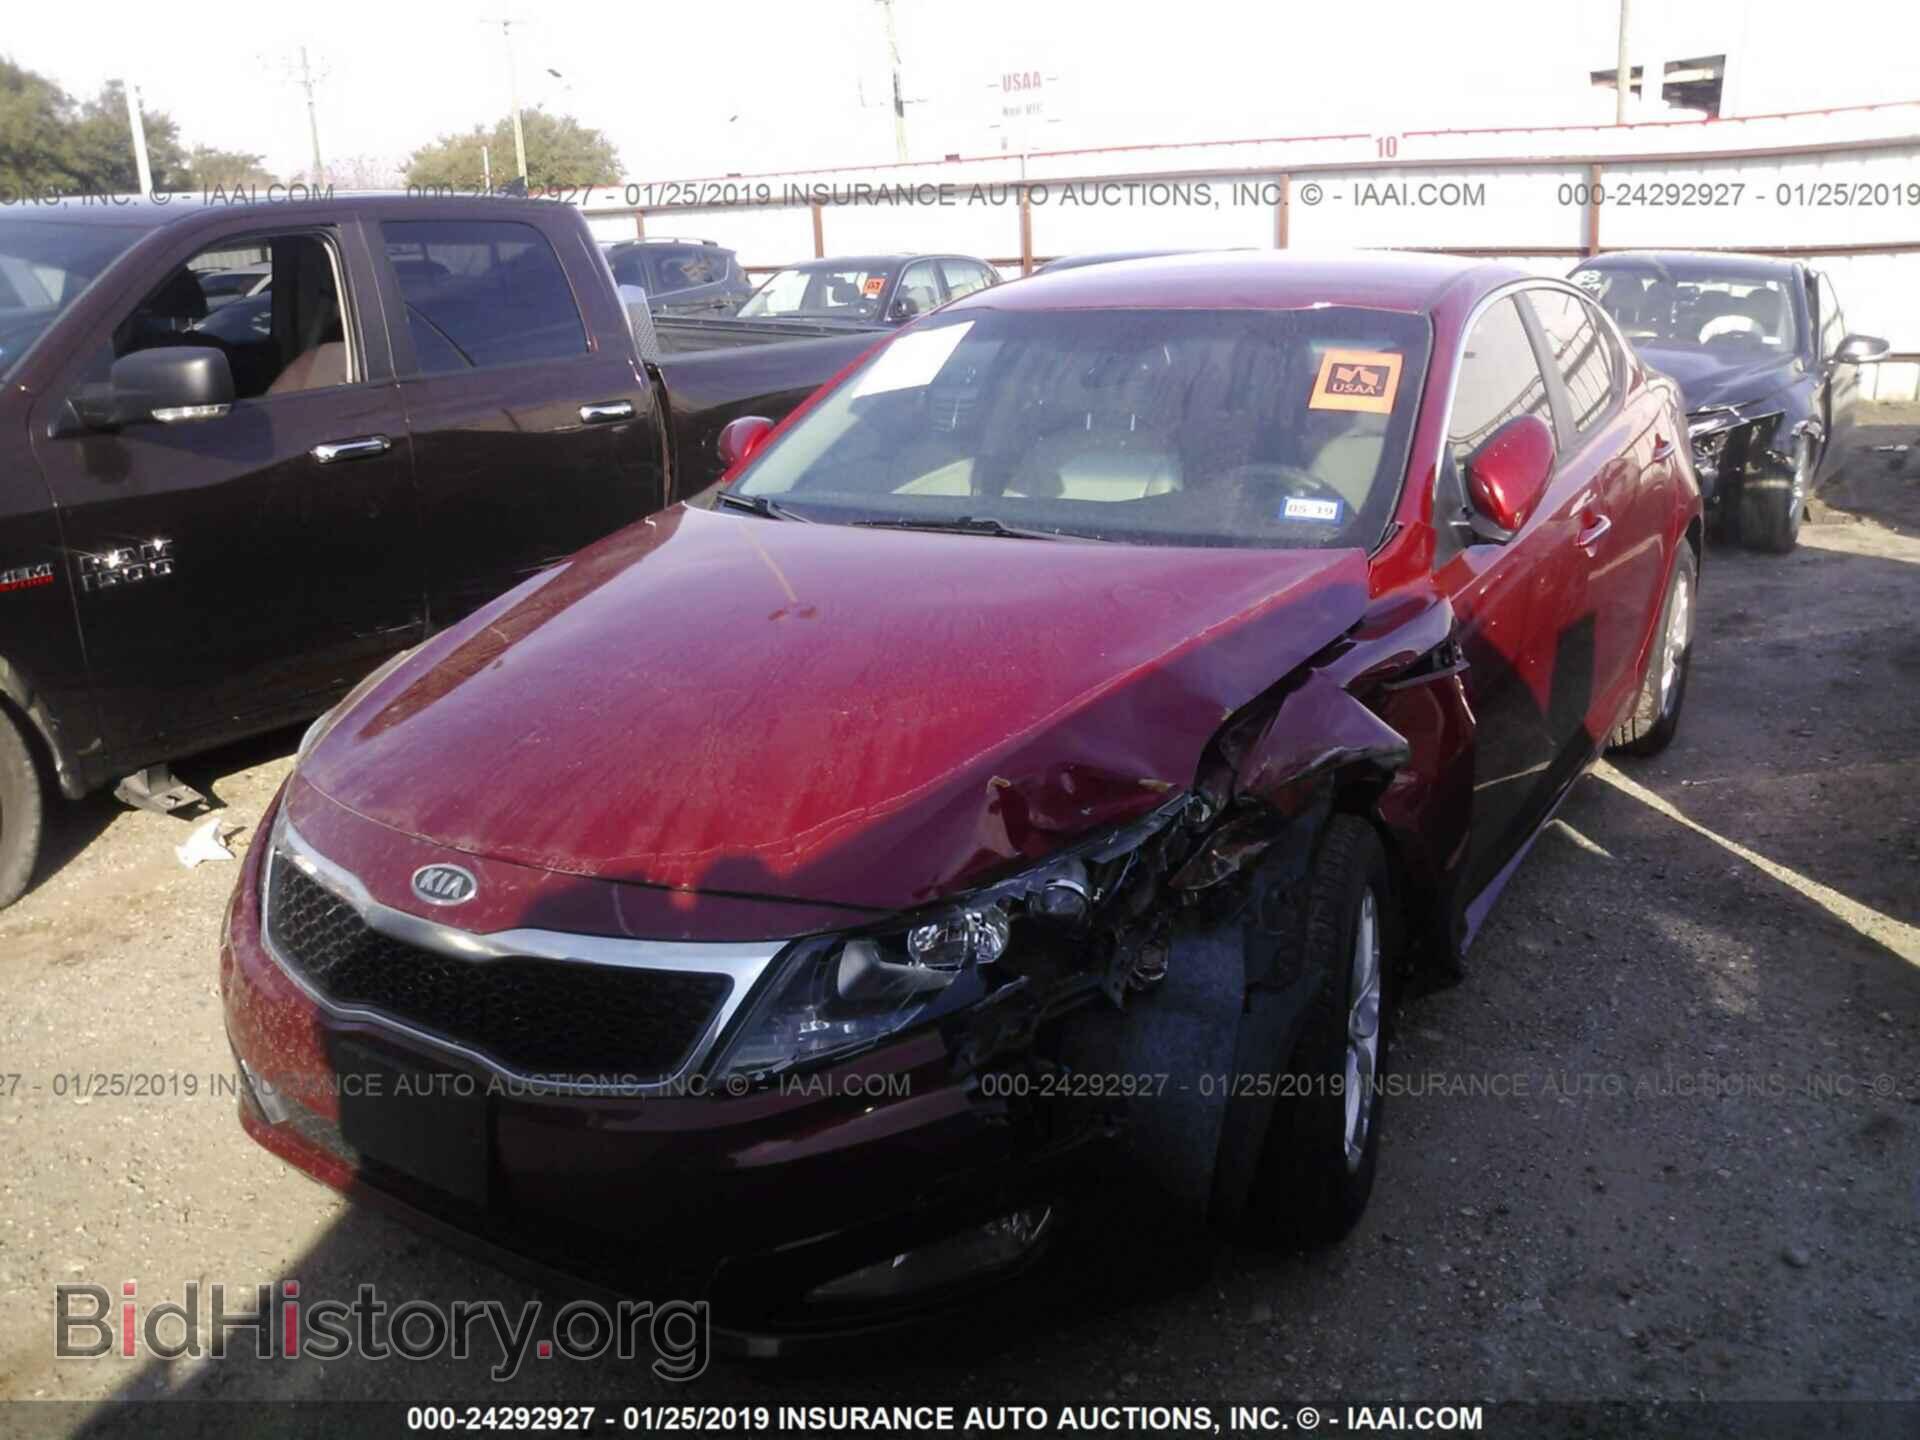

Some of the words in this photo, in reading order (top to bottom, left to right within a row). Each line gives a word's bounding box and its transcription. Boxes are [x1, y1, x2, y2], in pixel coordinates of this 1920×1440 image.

[1002, 71, 1041, 93] USAA
[1376, 136, 1398, 159] 10
[1332, 383, 1376, 394] USAA
[419, 868, 465, 898] KIA
